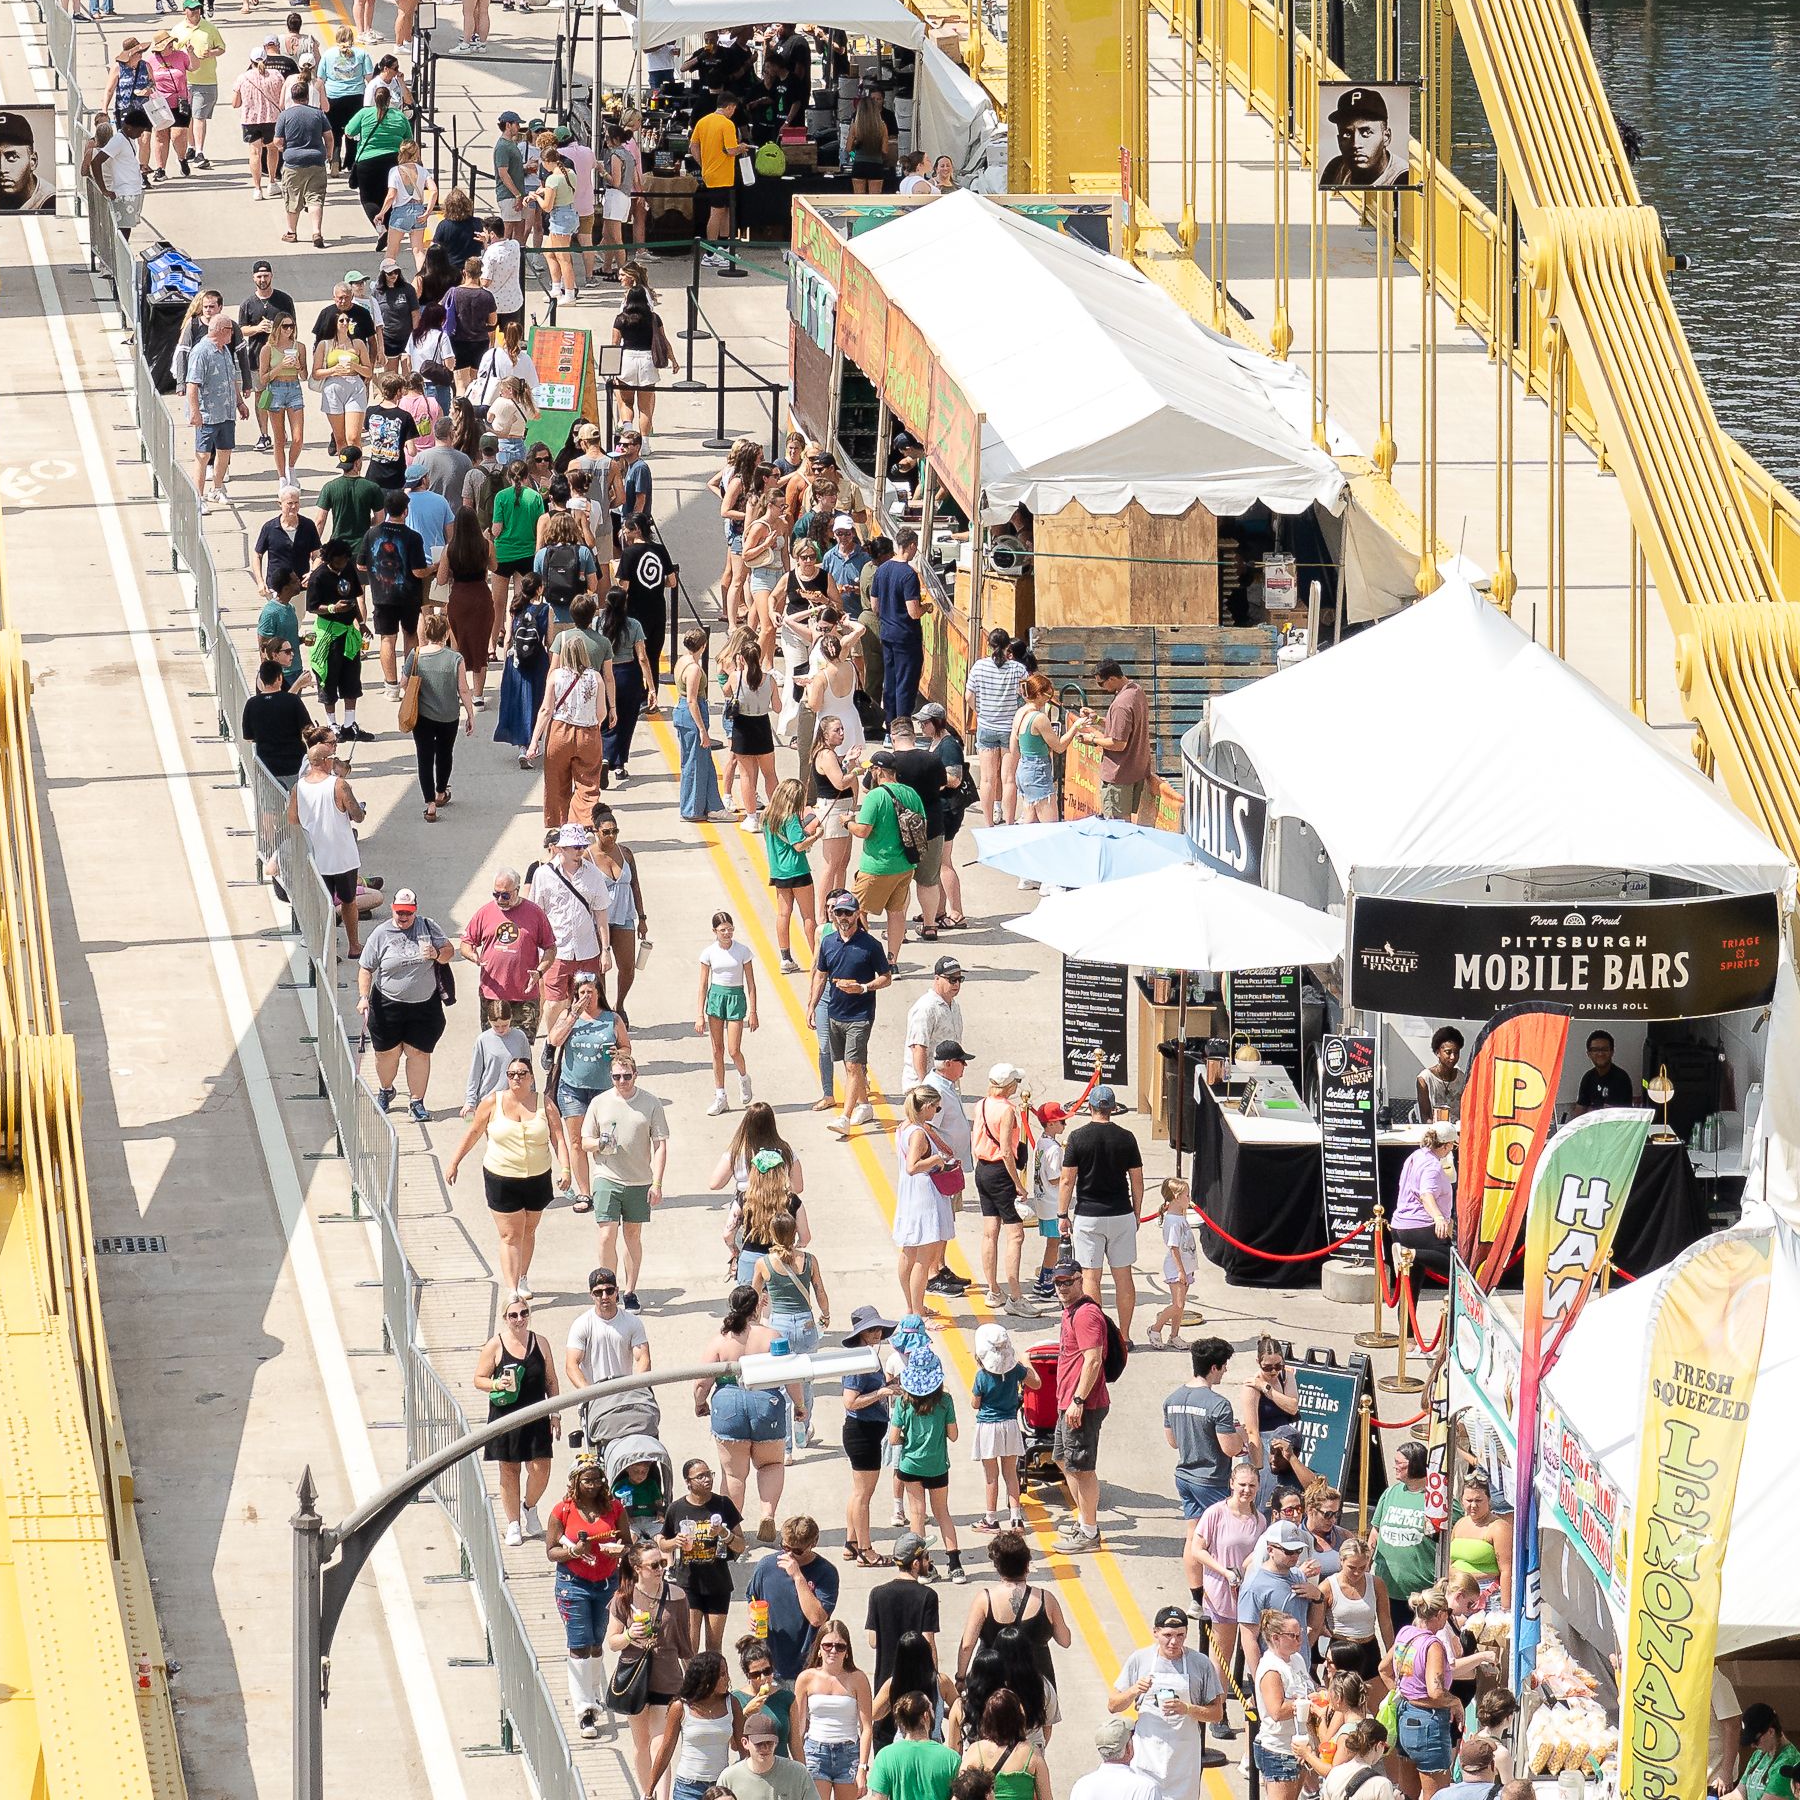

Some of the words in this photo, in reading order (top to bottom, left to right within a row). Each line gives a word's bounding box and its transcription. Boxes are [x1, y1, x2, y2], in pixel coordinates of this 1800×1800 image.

[1352, 92, 1362, 105] P
[1590, 912, 1621, 928] Proud
[1501, 935, 1648, 949] PITTSBURGH
[1722, 936, 1761, 950] TRIAGE
[1360, 954, 1419, 969] THISTLE
[1368, 962, 1409, 973] FINCH
[1719, 958, 1761, 972] SPIRITS
[1453, 954, 1590, 992] MOBILE
[1601, 951, 1691, 992] BARS
[1579, 1003, 1615, 1012] DRINKS
[1621, 1002, 1649, 1012] ROLL
[1673, 1360, 1736, 1397] FRESH
[1315, 1396, 1339, 1413] BARS
[1653, 1377, 1750, 1423] SQUEEZED
[1382, 1529, 1418, 1542] HEINZ
[1580, 1503, 1613, 1577] DRINKS
[1631, 1417, 1719, 1799] LEMONADE
